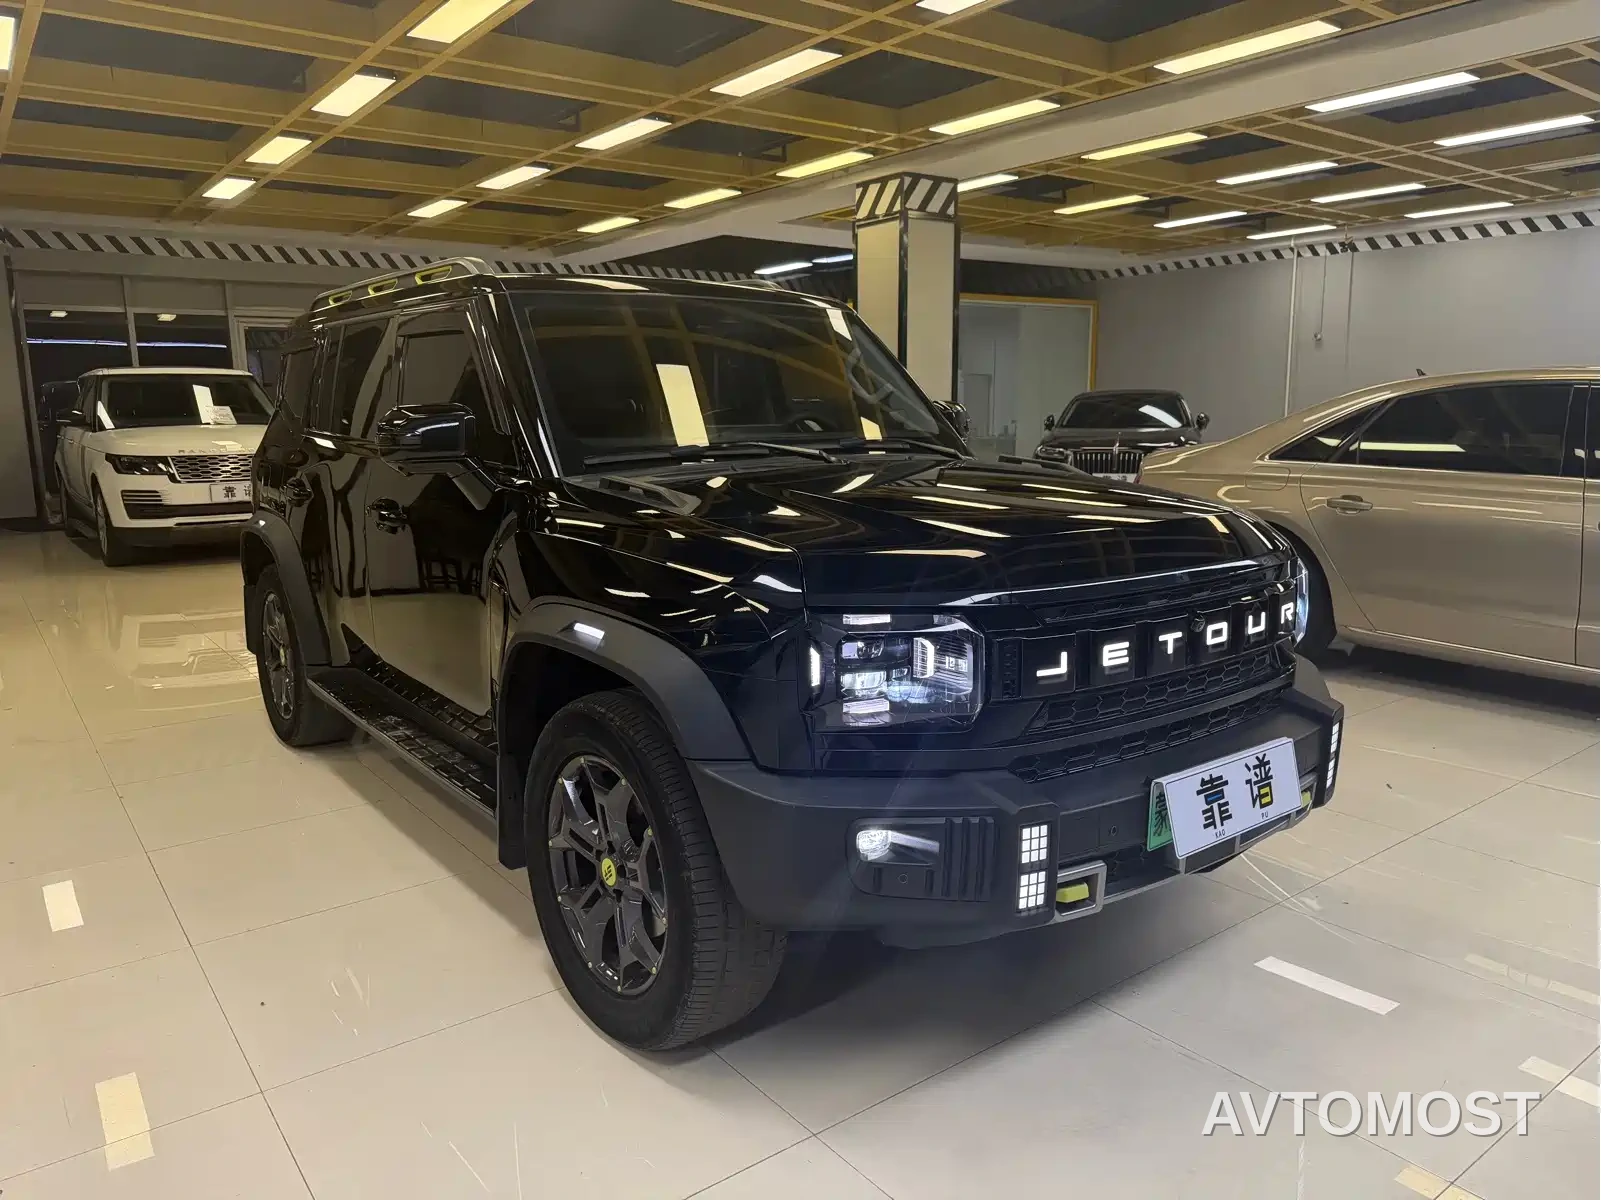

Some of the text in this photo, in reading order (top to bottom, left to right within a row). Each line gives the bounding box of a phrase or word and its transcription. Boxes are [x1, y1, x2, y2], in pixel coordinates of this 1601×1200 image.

[1036, 602, 1294, 677] JETOUR
[1196, 753, 1274, 829] 靠谱
[1215, 811, 1269, 839] KAO PU
